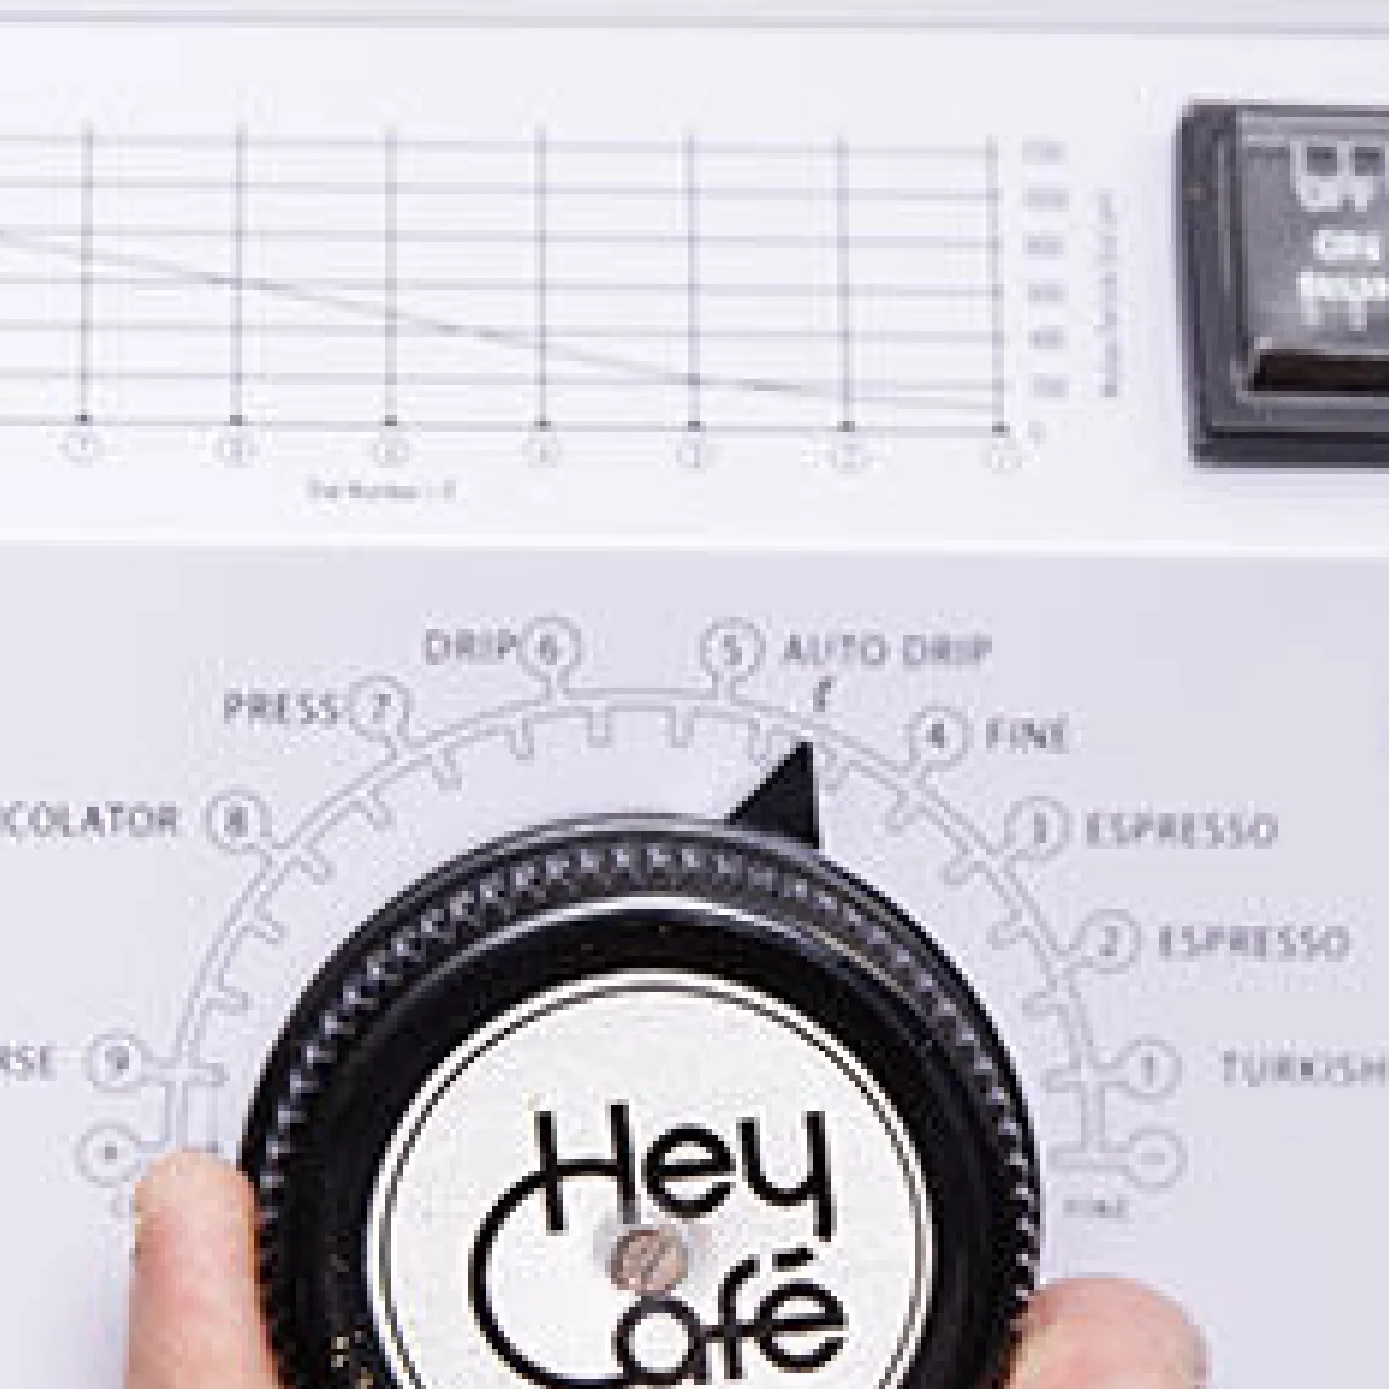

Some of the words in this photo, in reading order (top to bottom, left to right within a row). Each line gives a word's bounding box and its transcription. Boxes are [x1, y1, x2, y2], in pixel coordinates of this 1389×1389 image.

[423, 628, 517, 665] DRIP
[781, 632, 890, 668] AUTO
[901, 633, 994, 668] DRIP
[222, 691, 341, 727] PRESS
[985, 717, 1070, 752] FINE
[222, 804, 251, 840] 8
[1085, 812, 1280, 849] ESPRESSO
[1158, 924, 1352, 961] ESPRESSO
[1222, 1051, 1389, 1086] TURKISH
[534, 1103, 833, 1241] Hey
